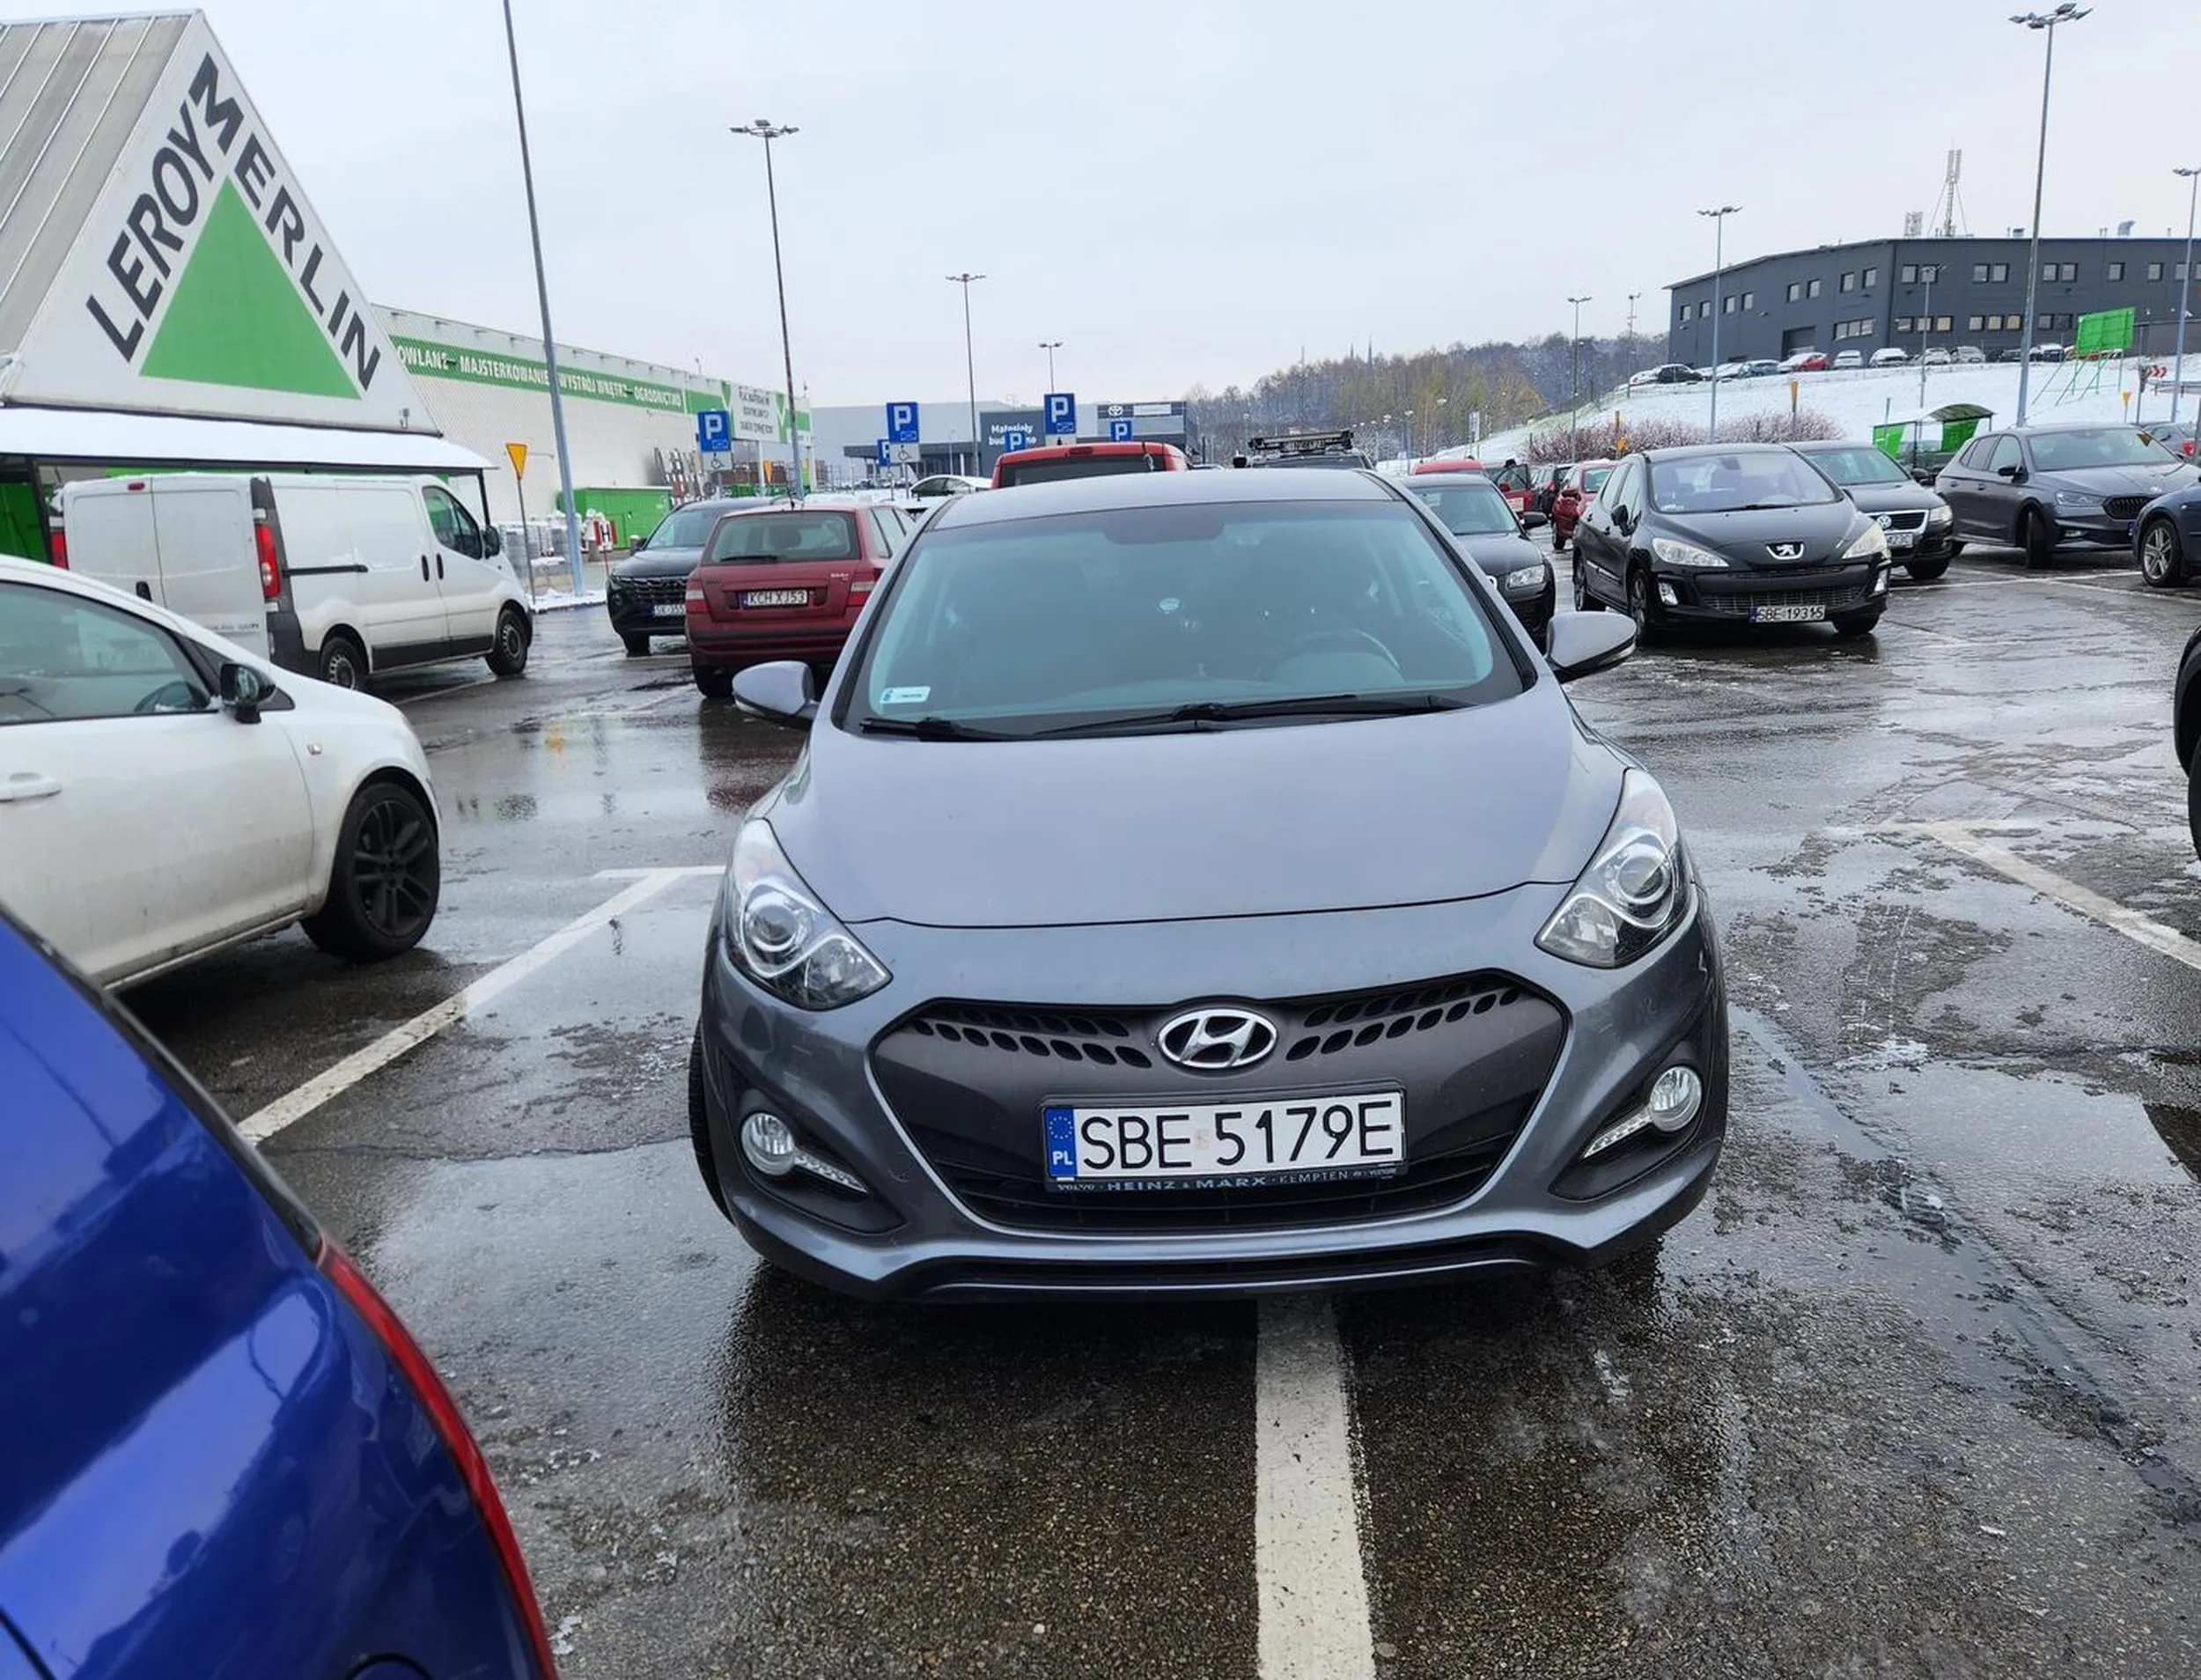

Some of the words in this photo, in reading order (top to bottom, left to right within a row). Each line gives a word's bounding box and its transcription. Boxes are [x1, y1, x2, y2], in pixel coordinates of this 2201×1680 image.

[86, 100, 214, 363] LEROY
[188, 52, 380, 391] MERLIN
[460, 356, 550, 386] MAJSTERKOWANIE
[894, 405, 912, 431] P
[1050, 396, 1069, 423] P
[705, 414, 722, 439] P
[1115, 423, 1128, 440] P
[1010, 433, 1021, 450] P
[600, 524, 611, 542] H
[749, 591, 772, 605] KCH
[1080, 1116, 1192, 1169] SBE
[1215, 1101, 1394, 1167] 5179E
[1052, 1151, 1072, 1165] PL
[1107, 1180, 1176, 1191] HEINZ
[1196, 1177, 1266, 1190] MARX
[1279, 1170, 1348, 1183] KEMPTEN
